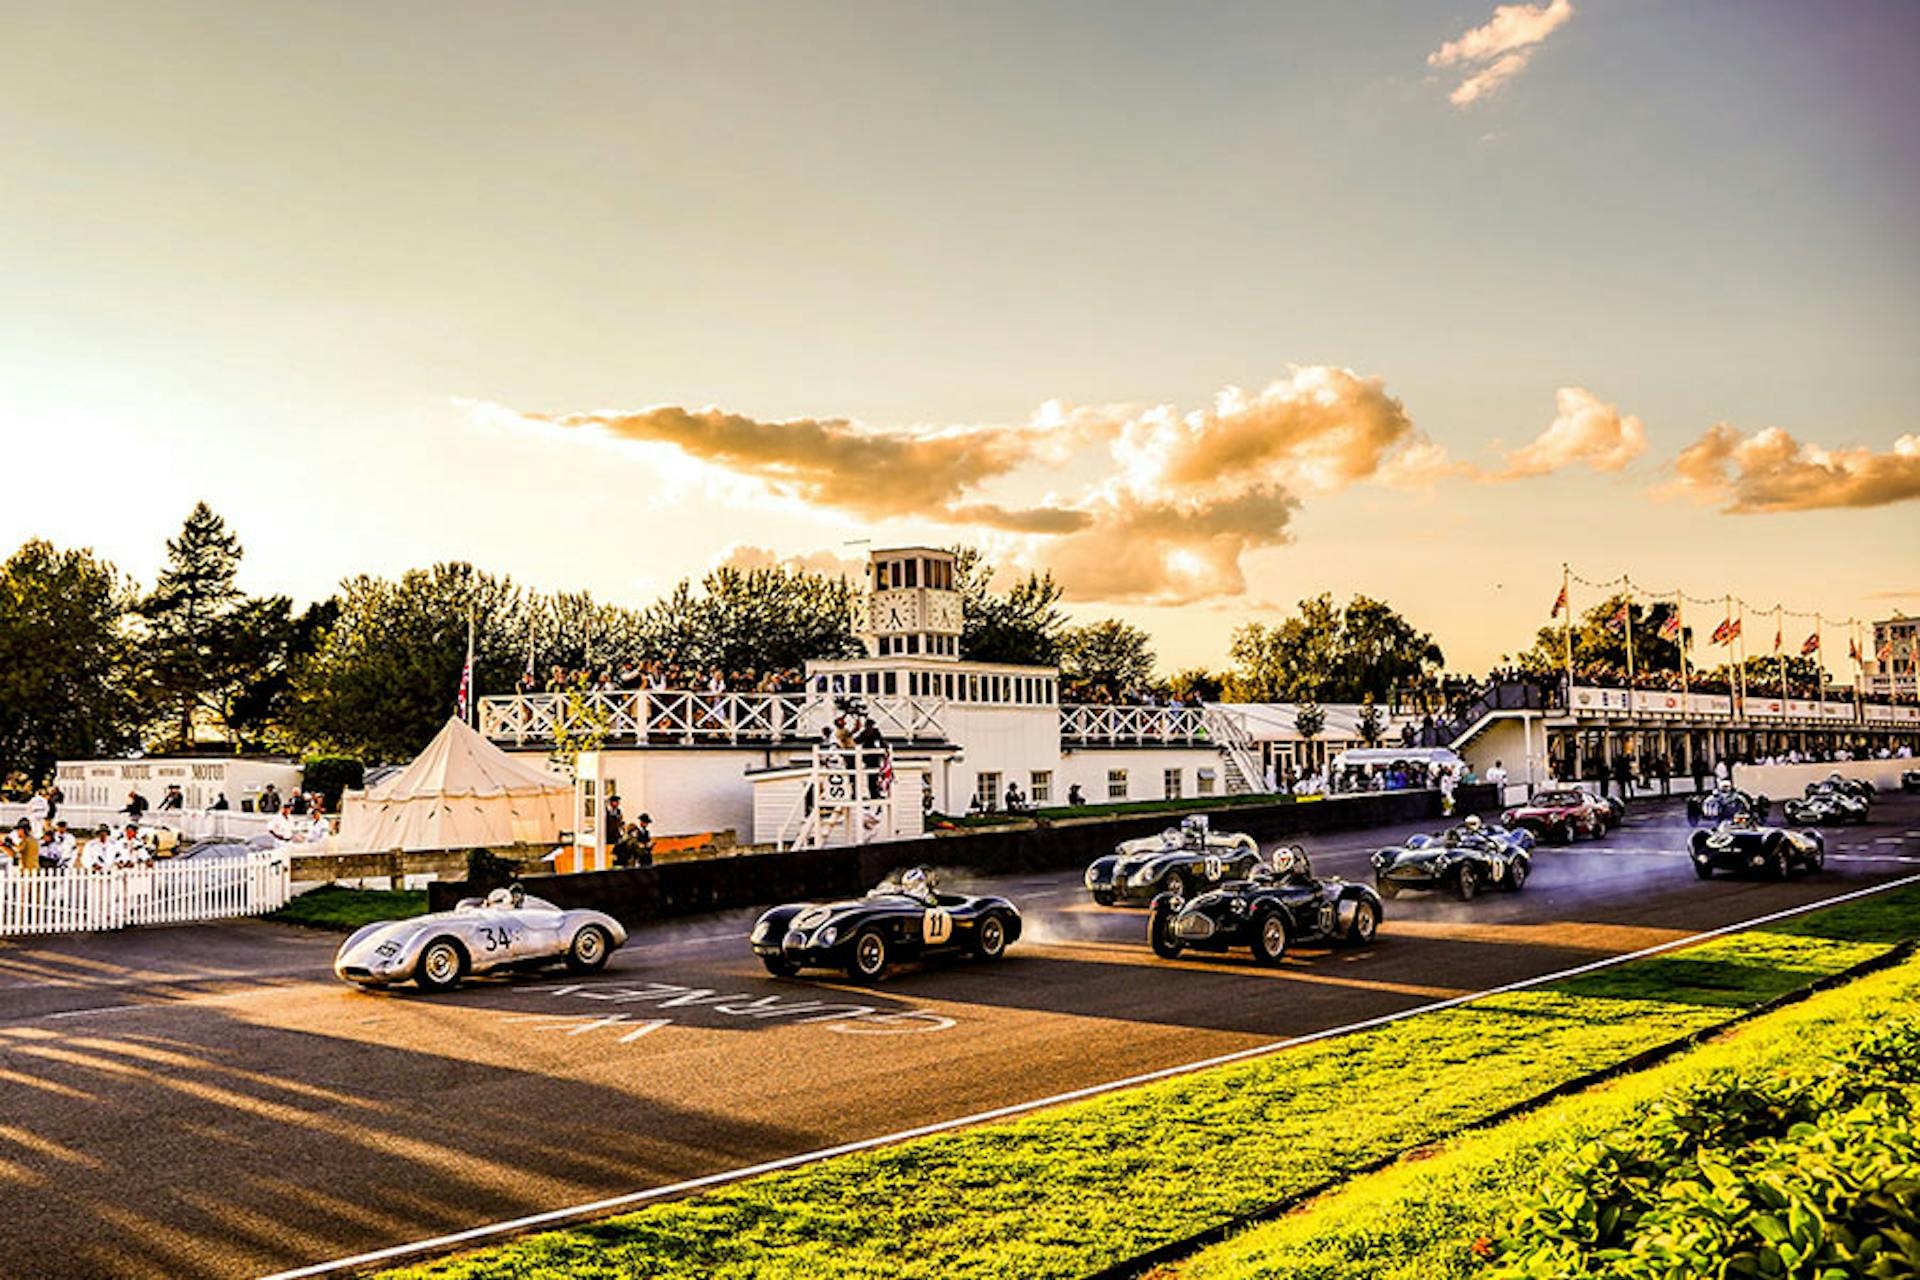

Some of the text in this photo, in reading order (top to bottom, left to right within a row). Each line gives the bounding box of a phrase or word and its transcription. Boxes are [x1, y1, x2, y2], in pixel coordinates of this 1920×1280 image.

[121, 764, 152, 781] MOTUL
[929, 911, 943, 937] 11
[480, 926, 512, 952] 34
